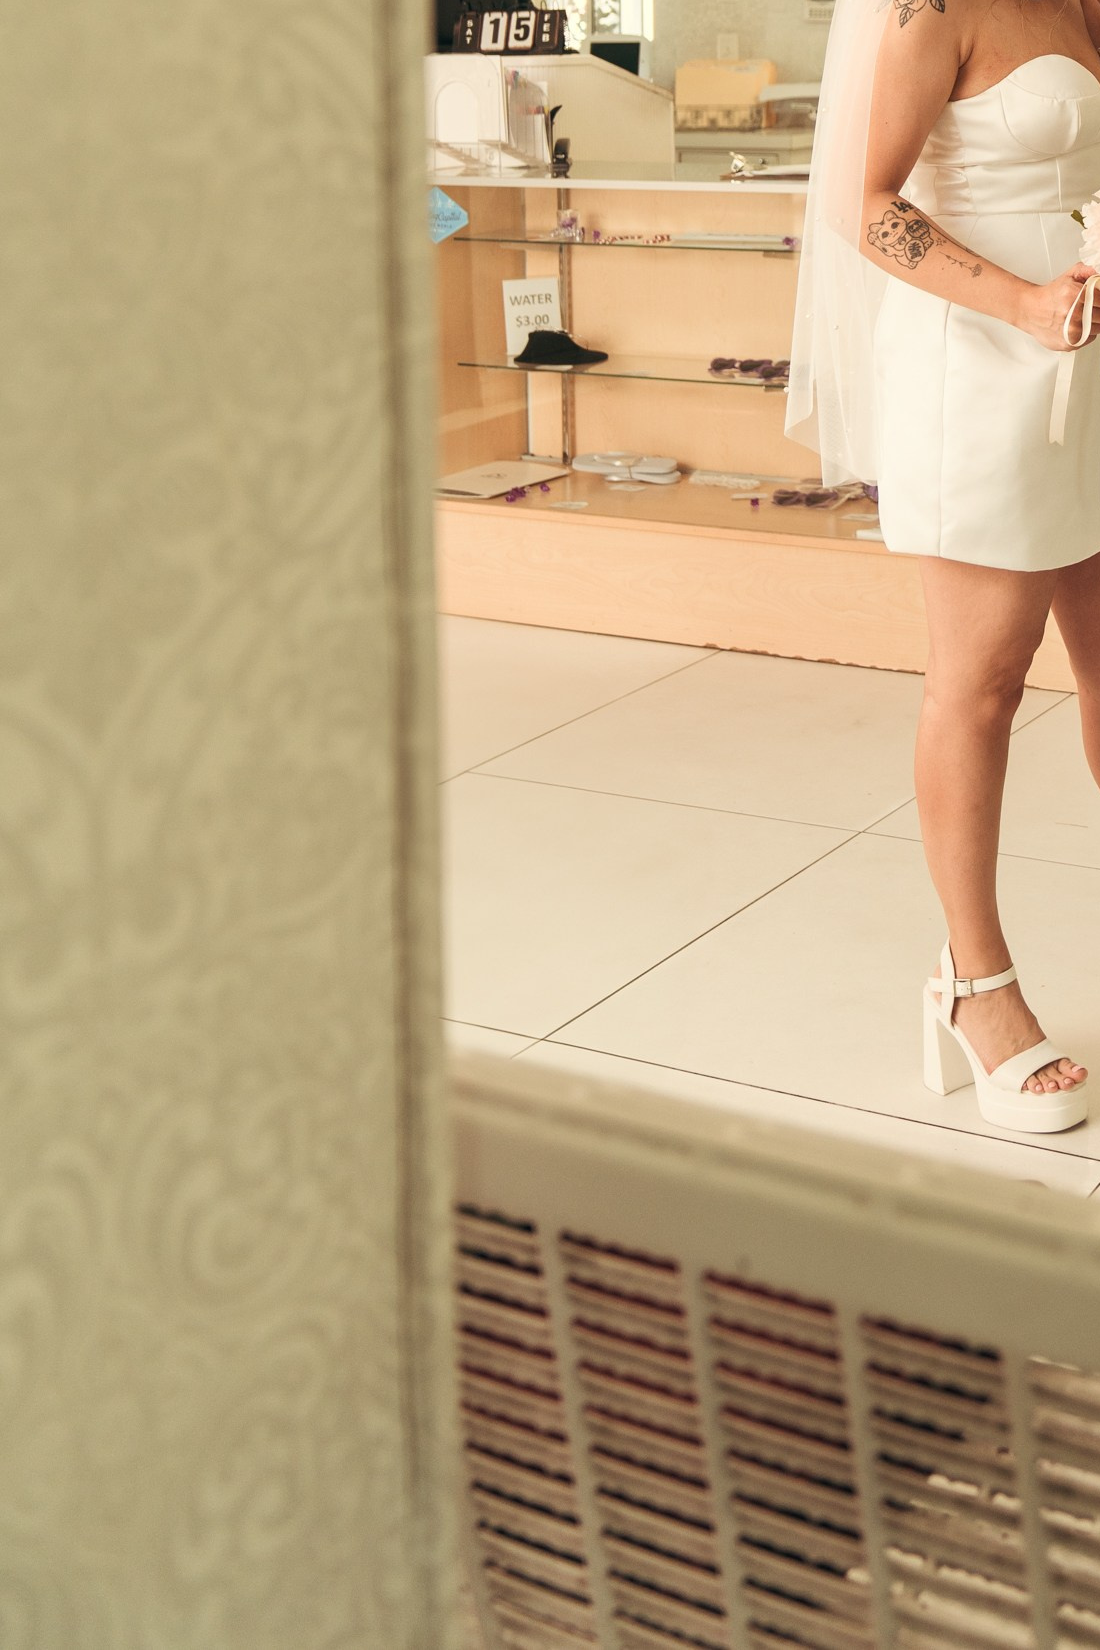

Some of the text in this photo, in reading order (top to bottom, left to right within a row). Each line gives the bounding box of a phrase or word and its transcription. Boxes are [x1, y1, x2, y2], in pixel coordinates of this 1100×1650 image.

[466, 13, 551, 44] SAT 15 FEB
[509, 292, 552, 306] WATER
[516, 314, 550, 328] $3.00
